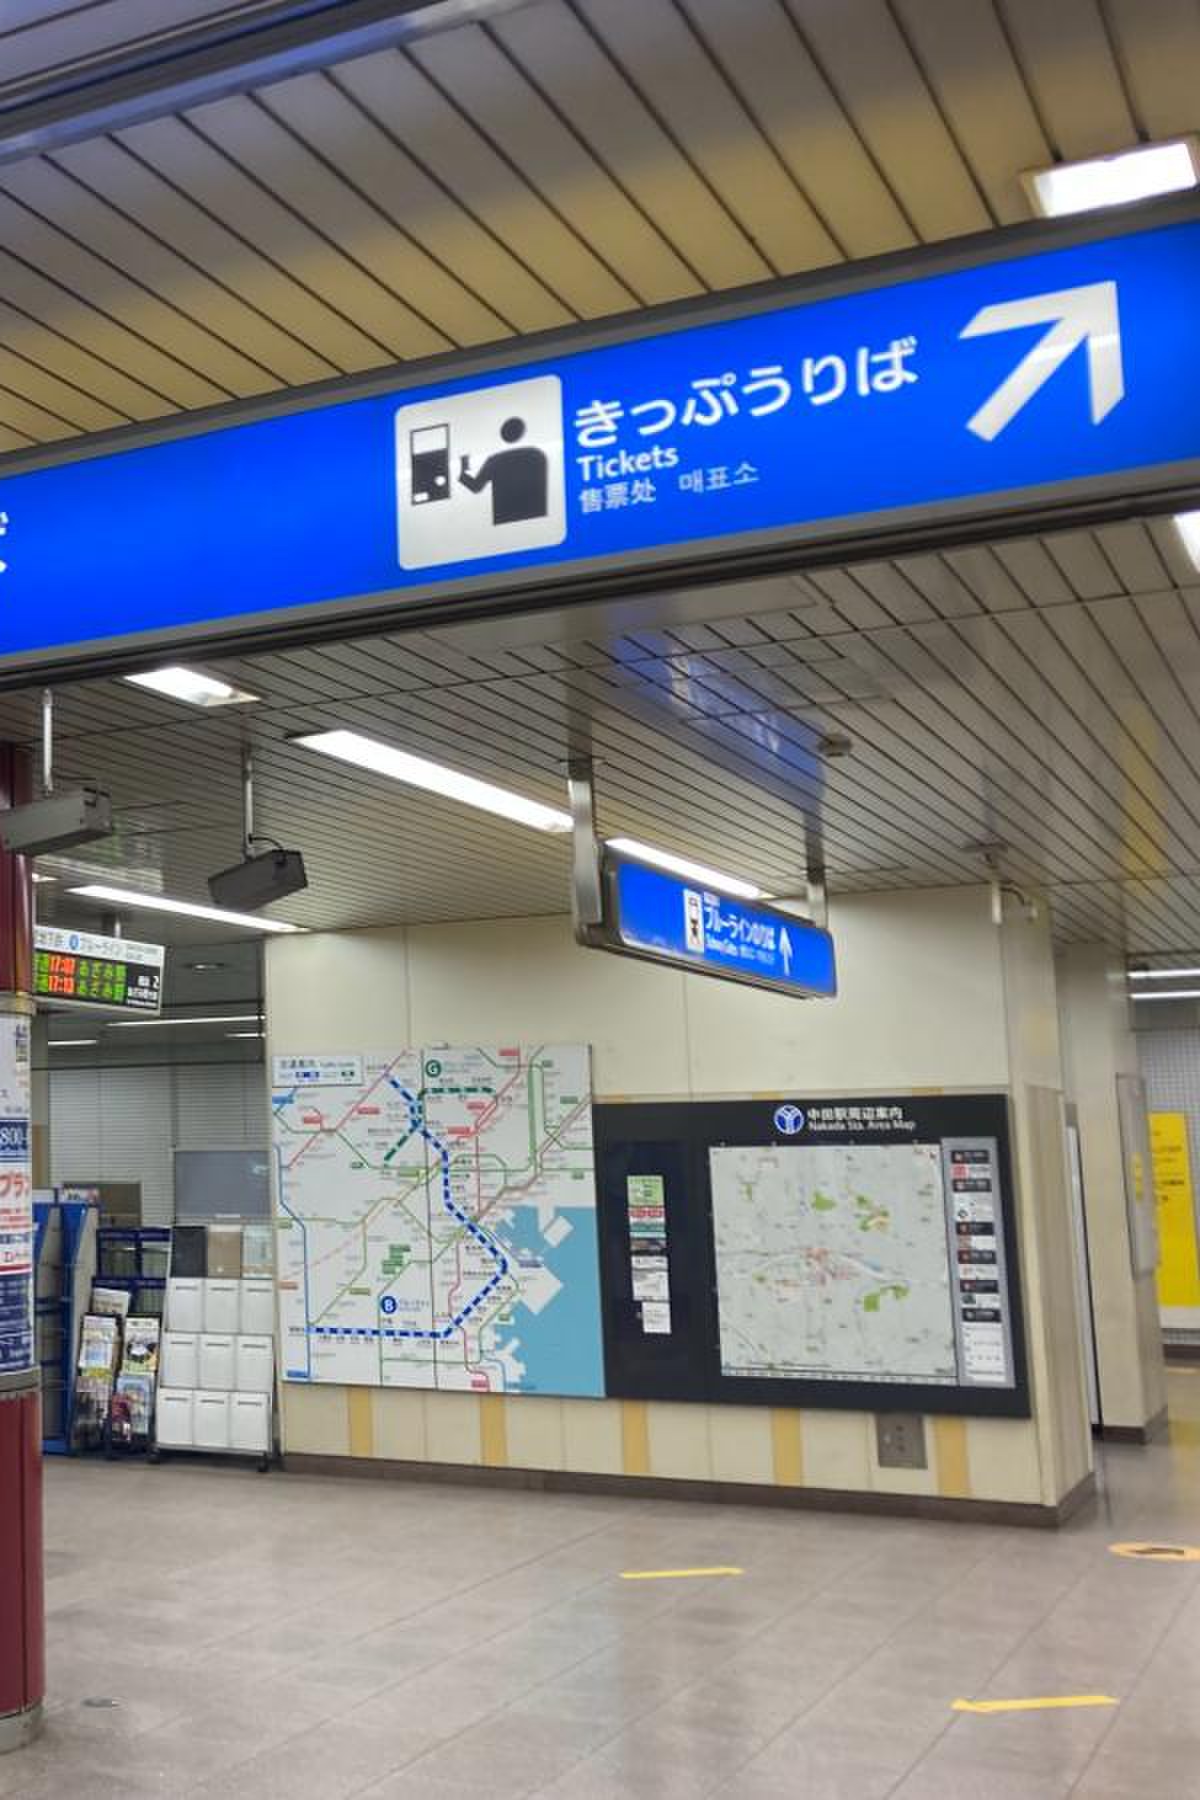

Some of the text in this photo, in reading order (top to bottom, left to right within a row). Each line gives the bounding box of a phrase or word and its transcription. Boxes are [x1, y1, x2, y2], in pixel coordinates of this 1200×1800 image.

[573, 335, 919, 447] きっぷうりば
[577, 446, 678, 481] Tickets
[678, 461, 759, 494] 매표소
[579, 480, 656, 513] 售票处
